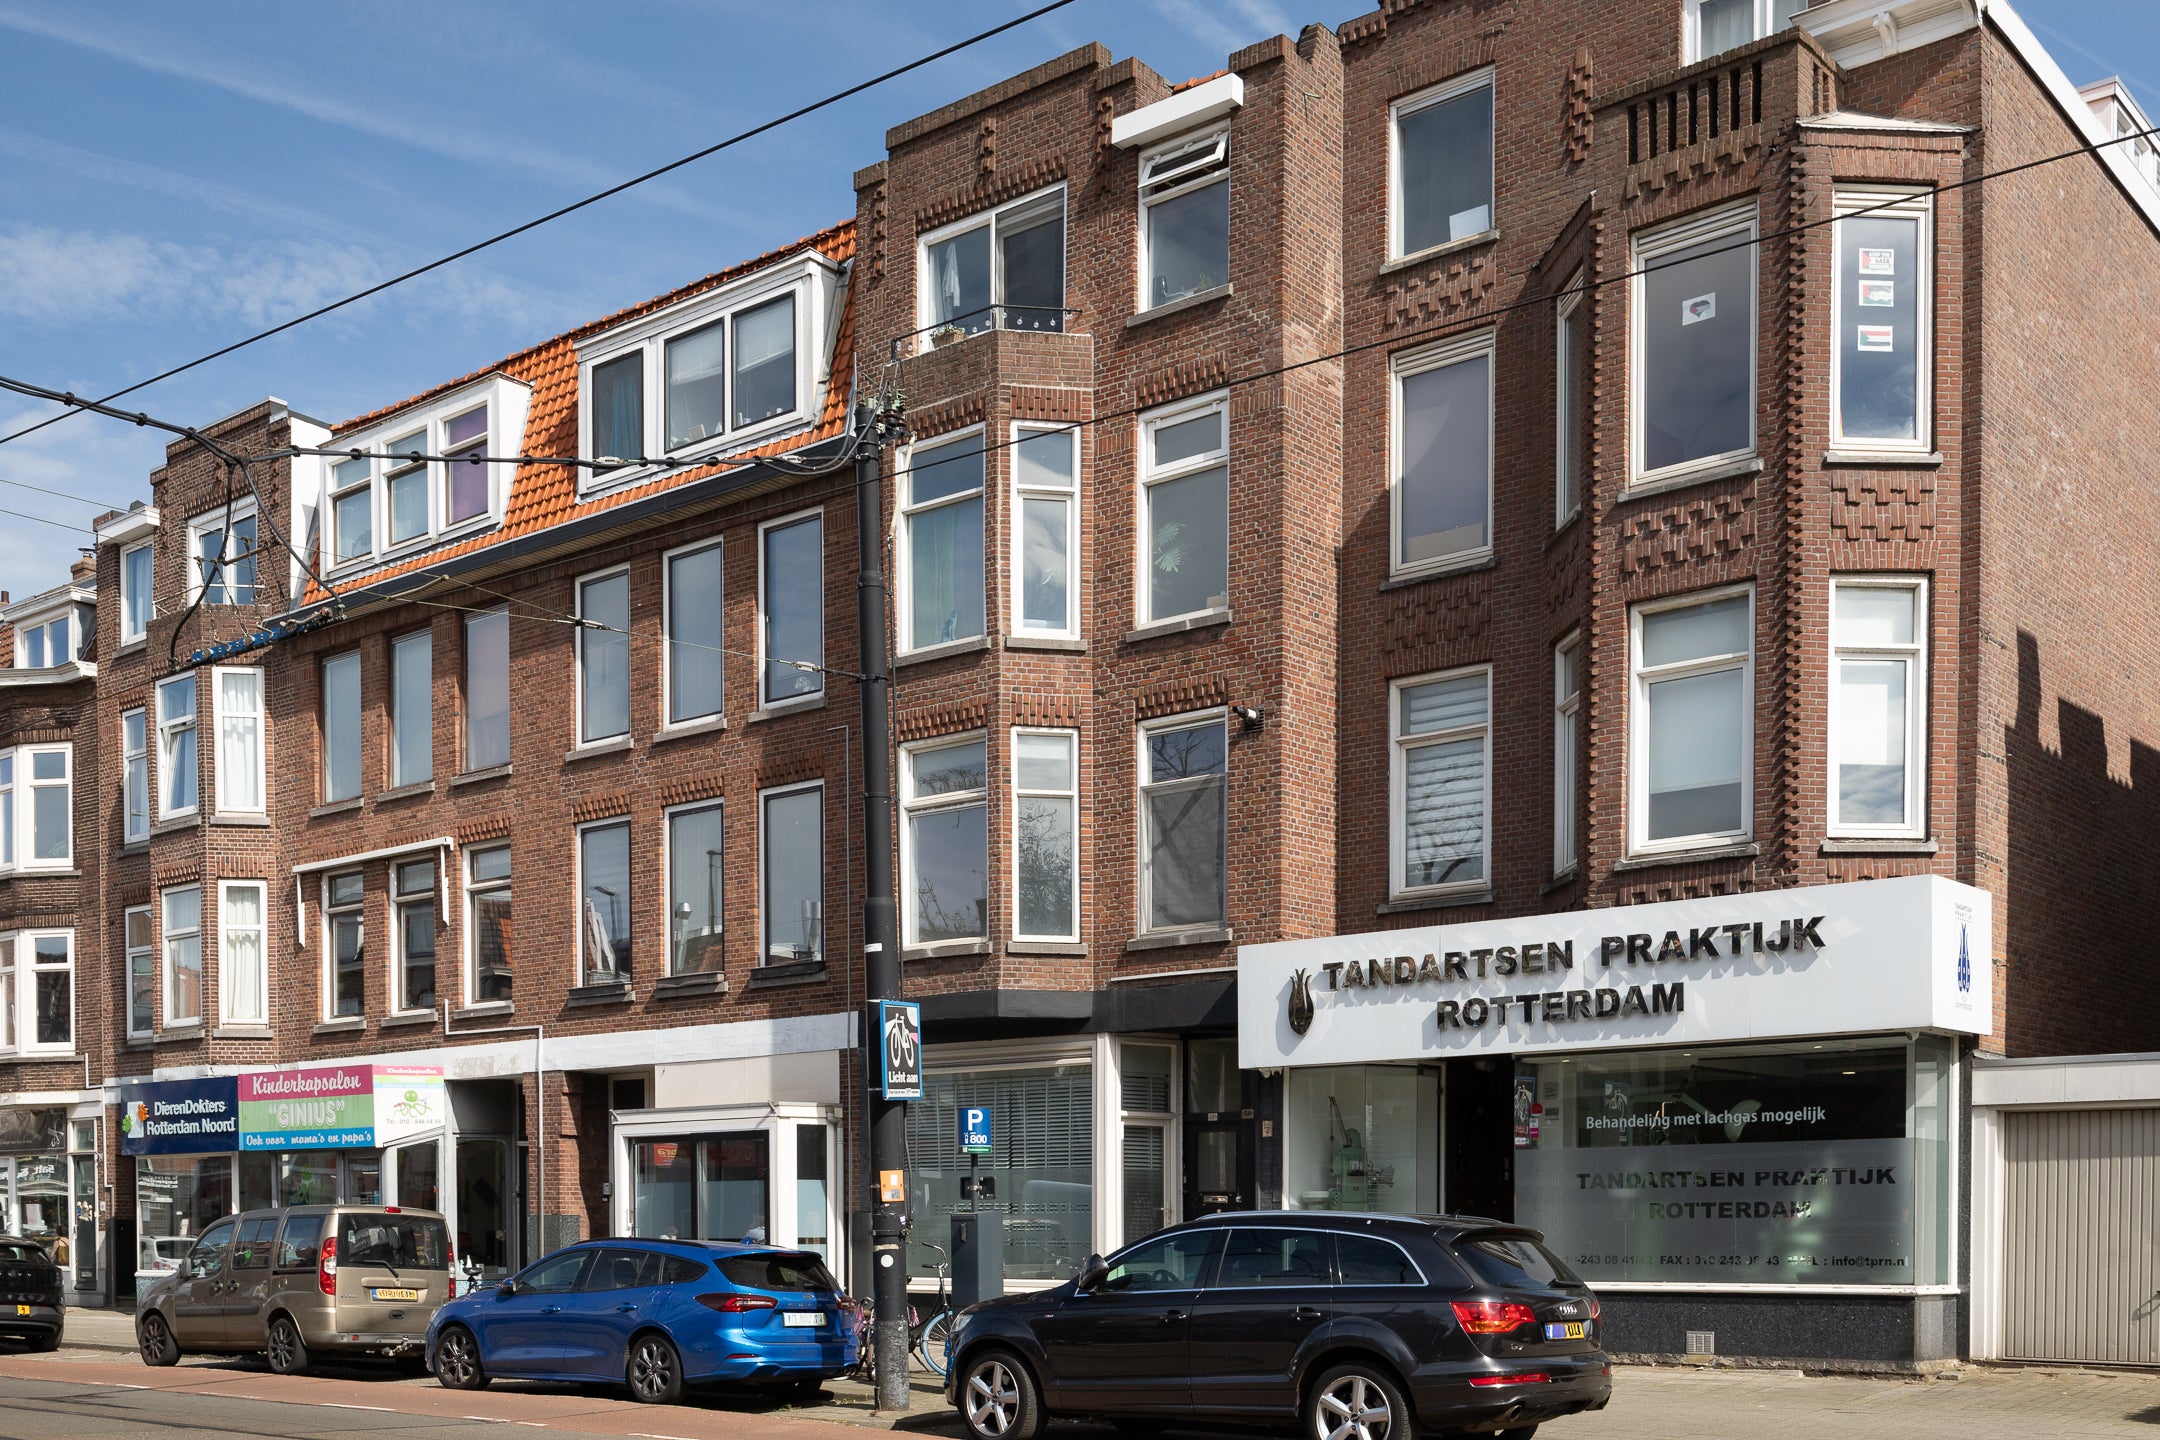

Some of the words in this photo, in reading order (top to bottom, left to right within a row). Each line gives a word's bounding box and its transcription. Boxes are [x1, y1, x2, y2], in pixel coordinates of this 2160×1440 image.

[1322, 940, 1573, 992] TANDARTSEN
[1600, 916, 1827, 967] PRAKTIJK
[1436, 982, 1685, 1030] ROTTERDAM
[252, 1070, 362, 1095] Kinderkapsalon
[888, 1071, 906, 1083] Licht
[906, 1074, 918, 1083] aan
[154, 1099, 227, 1116] DierenDokters
[147, 1119, 200, 1136] Rotterdam
[202, 1117, 236, 1134] Noord
[968, 1110, 983, 1131] P
[1586, 1112, 1670, 1129] Behandeling
[1674, 1112, 1701, 1126] met
[1704, 1109, 1758, 1126] lachgas
[1761, 1106, 1826, 1124] mogelijk
[246, 1134, 263, 1145] Ook
[265, 1136, 286, 1145] voor
[291, 1132, 325, 1145] mama's
[328, 1134, 339, 1143] en
[341, 1130, 372, 1145] papa's
[970, 1134, 987, 1144] 800
[1576, 1170, 1745, 1189] TANDARTSEN
[1754, 1167, 1897, 1186] PRAKTIJK
[1649, 1200, 1812, 1219] ROTTERDAM
[1604, 1255, 1618, 1265] 08
[1660, 1255, 1683, 1265] FAX
[1695, 1255, 1742, 1265] 010-243
[1832, 1256, 1909, 1268] info@tprn.nl
